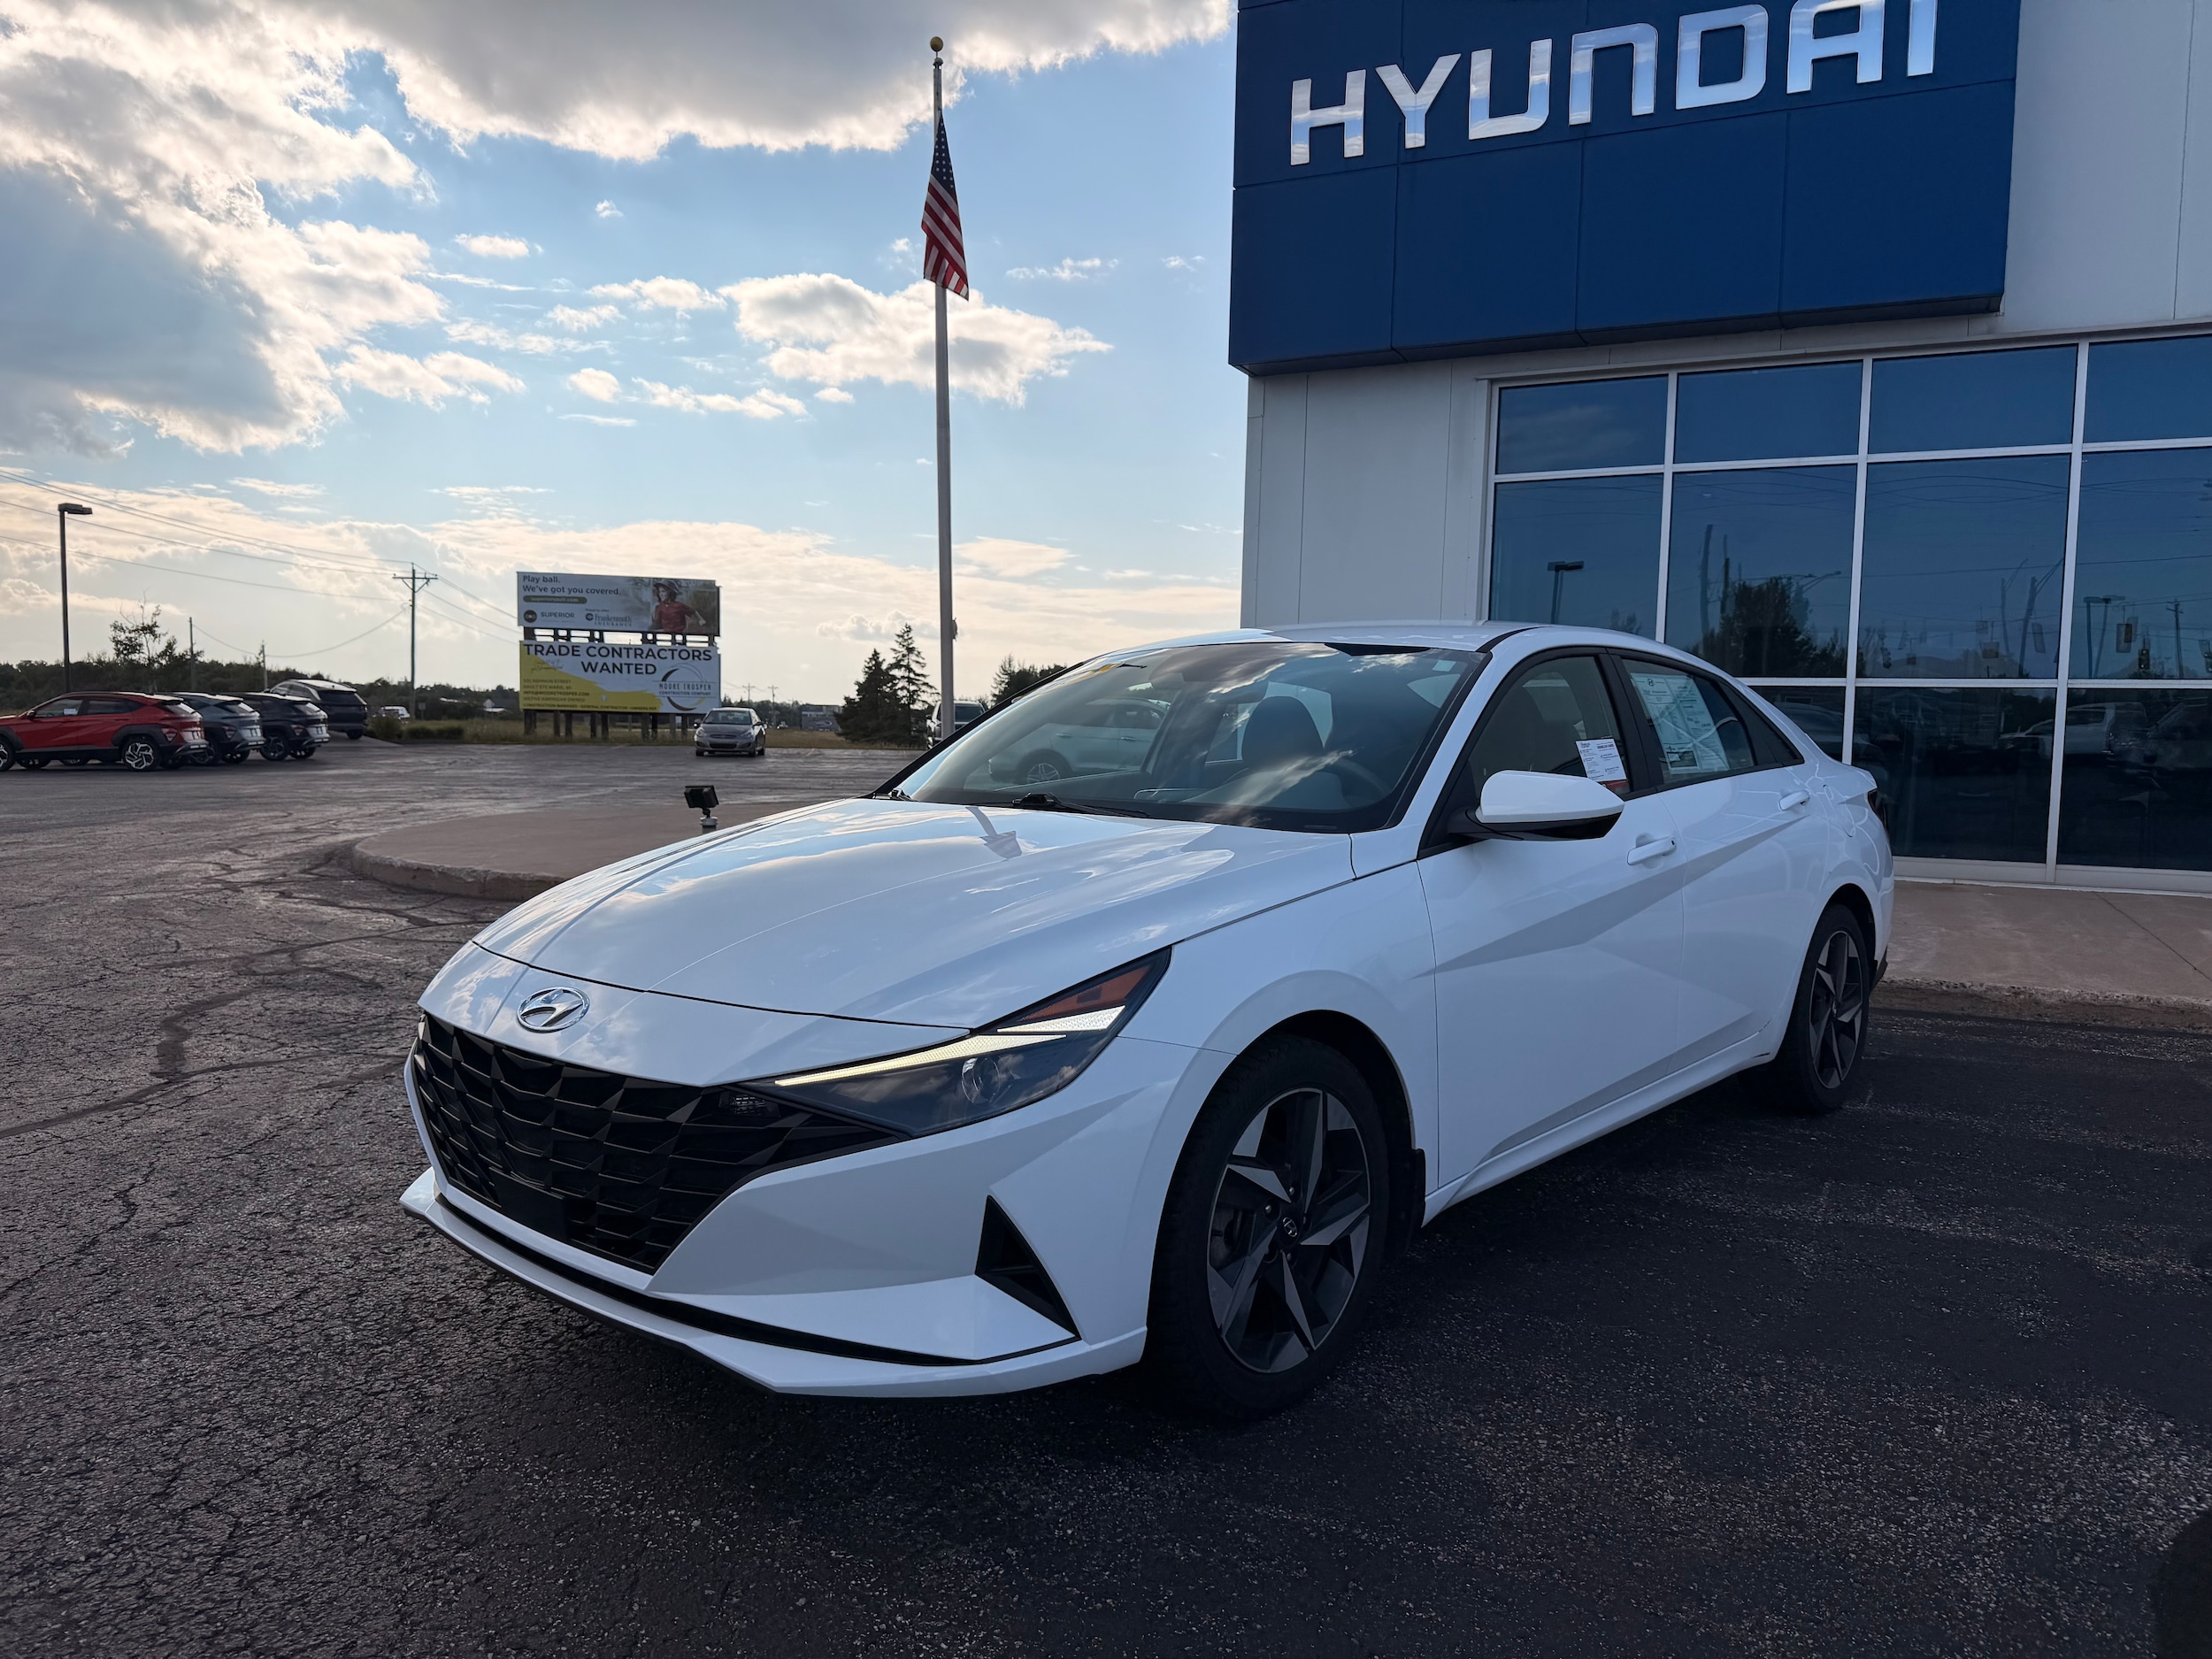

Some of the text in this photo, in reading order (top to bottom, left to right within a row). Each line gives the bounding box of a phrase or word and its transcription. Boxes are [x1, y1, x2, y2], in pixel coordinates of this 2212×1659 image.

[1289, 0, 1938, 165] HYUNDAI
[524, 644, 711, 661] TRADE CONTRACTORS
[581, 662, 657, 675] WANTED
